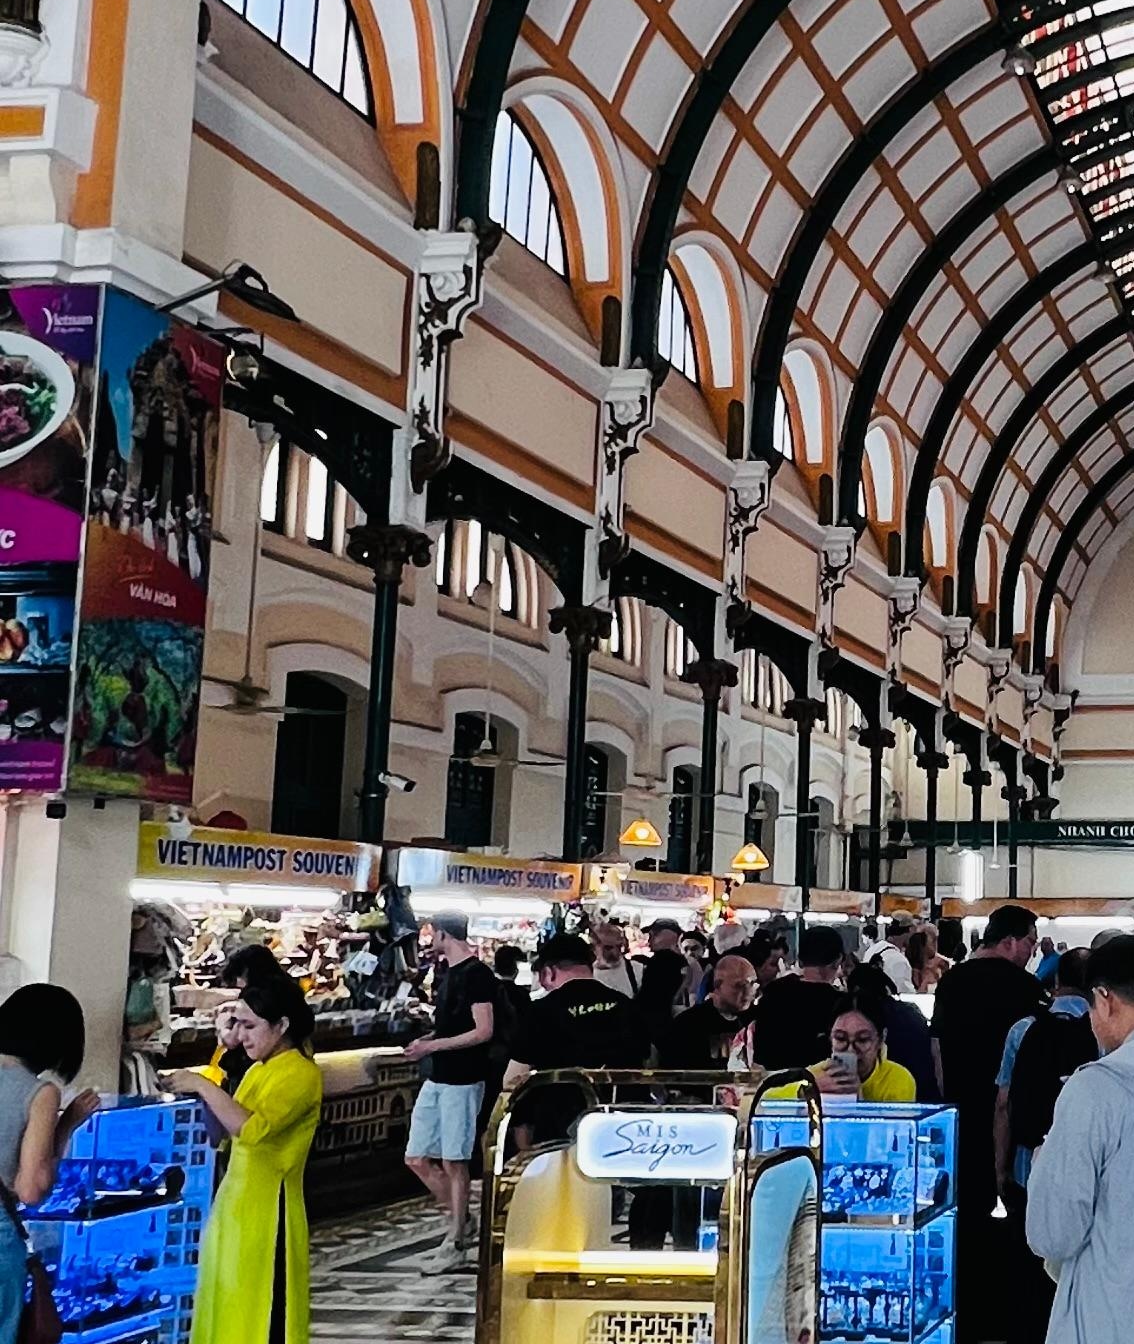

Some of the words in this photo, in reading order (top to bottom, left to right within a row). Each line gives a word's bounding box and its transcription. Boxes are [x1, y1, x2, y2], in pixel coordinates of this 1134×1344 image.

[1057, 825, 1106, 838] NHANH
[158, 839, 287, 871] VIETNAMPOST
[446, 864, 524, 888] VIETNAMPOST
[637, 1122, 678, 1139] MIS
[602, 1119, 717, 1172] Saigon
